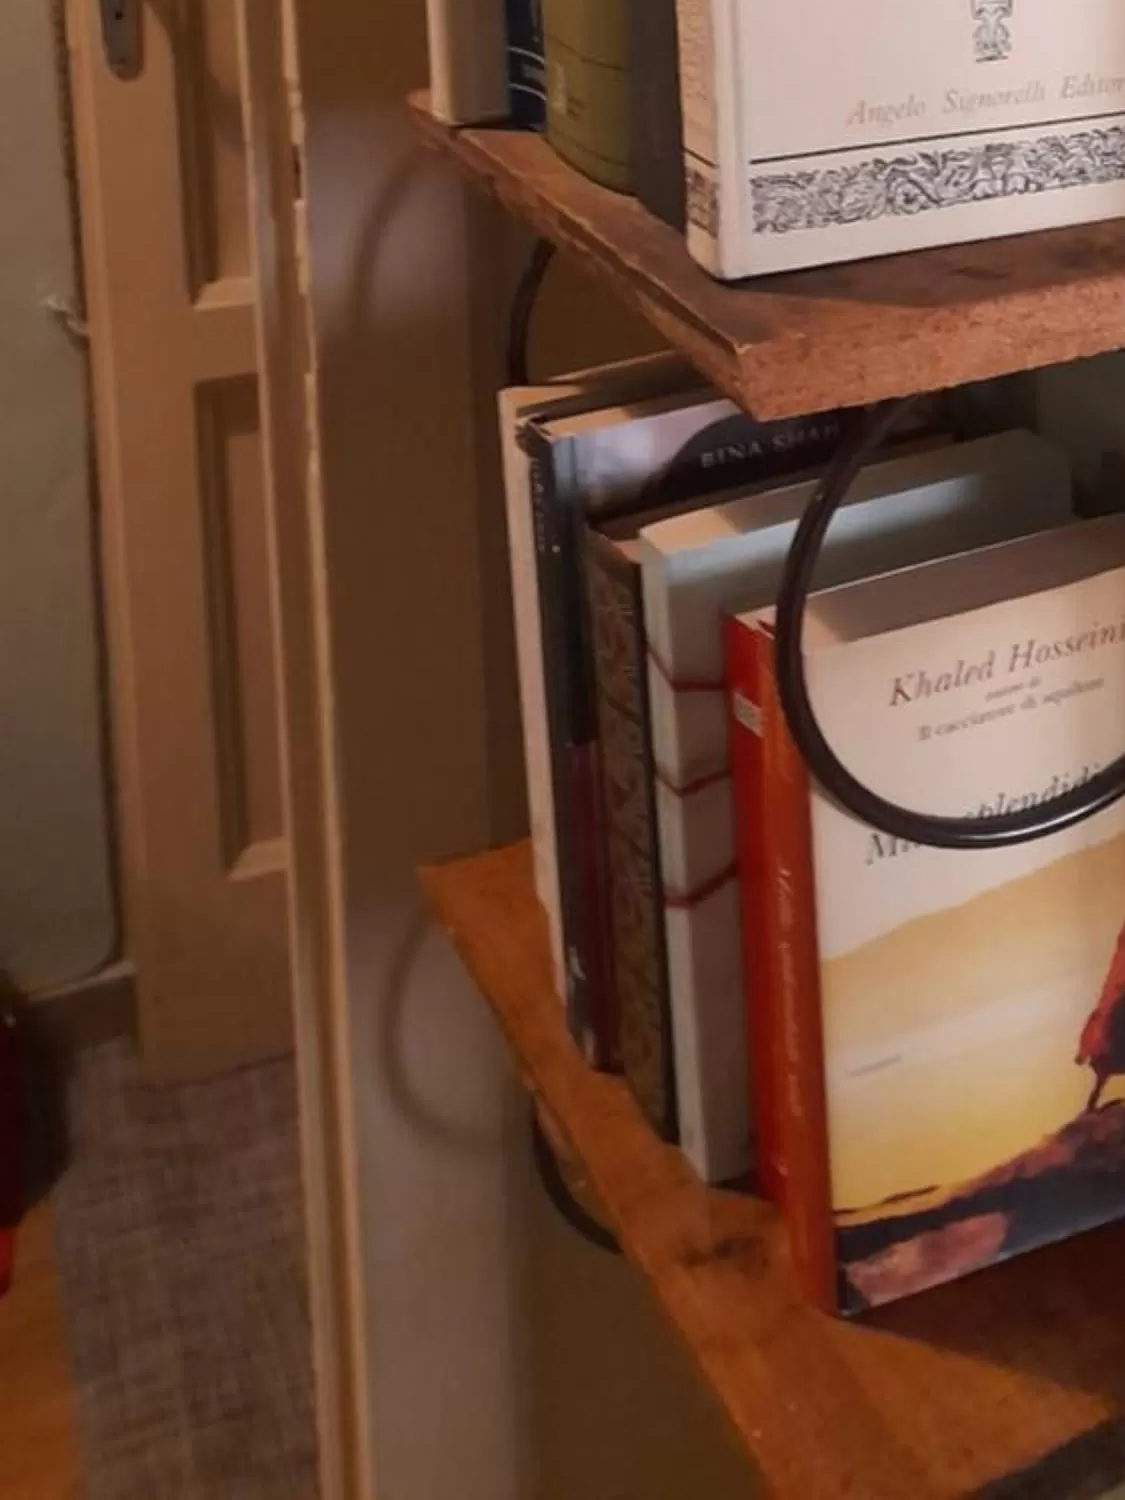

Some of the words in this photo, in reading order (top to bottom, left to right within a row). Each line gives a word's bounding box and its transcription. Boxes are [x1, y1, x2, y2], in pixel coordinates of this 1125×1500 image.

[846, 93, 927, 127] Angelo
[943, 80, 1047, 116] Signorelli
[702, 440, 763, 469] BINA
[772, 420, 841, 449] SHAH
[889, 650, 997, 707] Khaled
